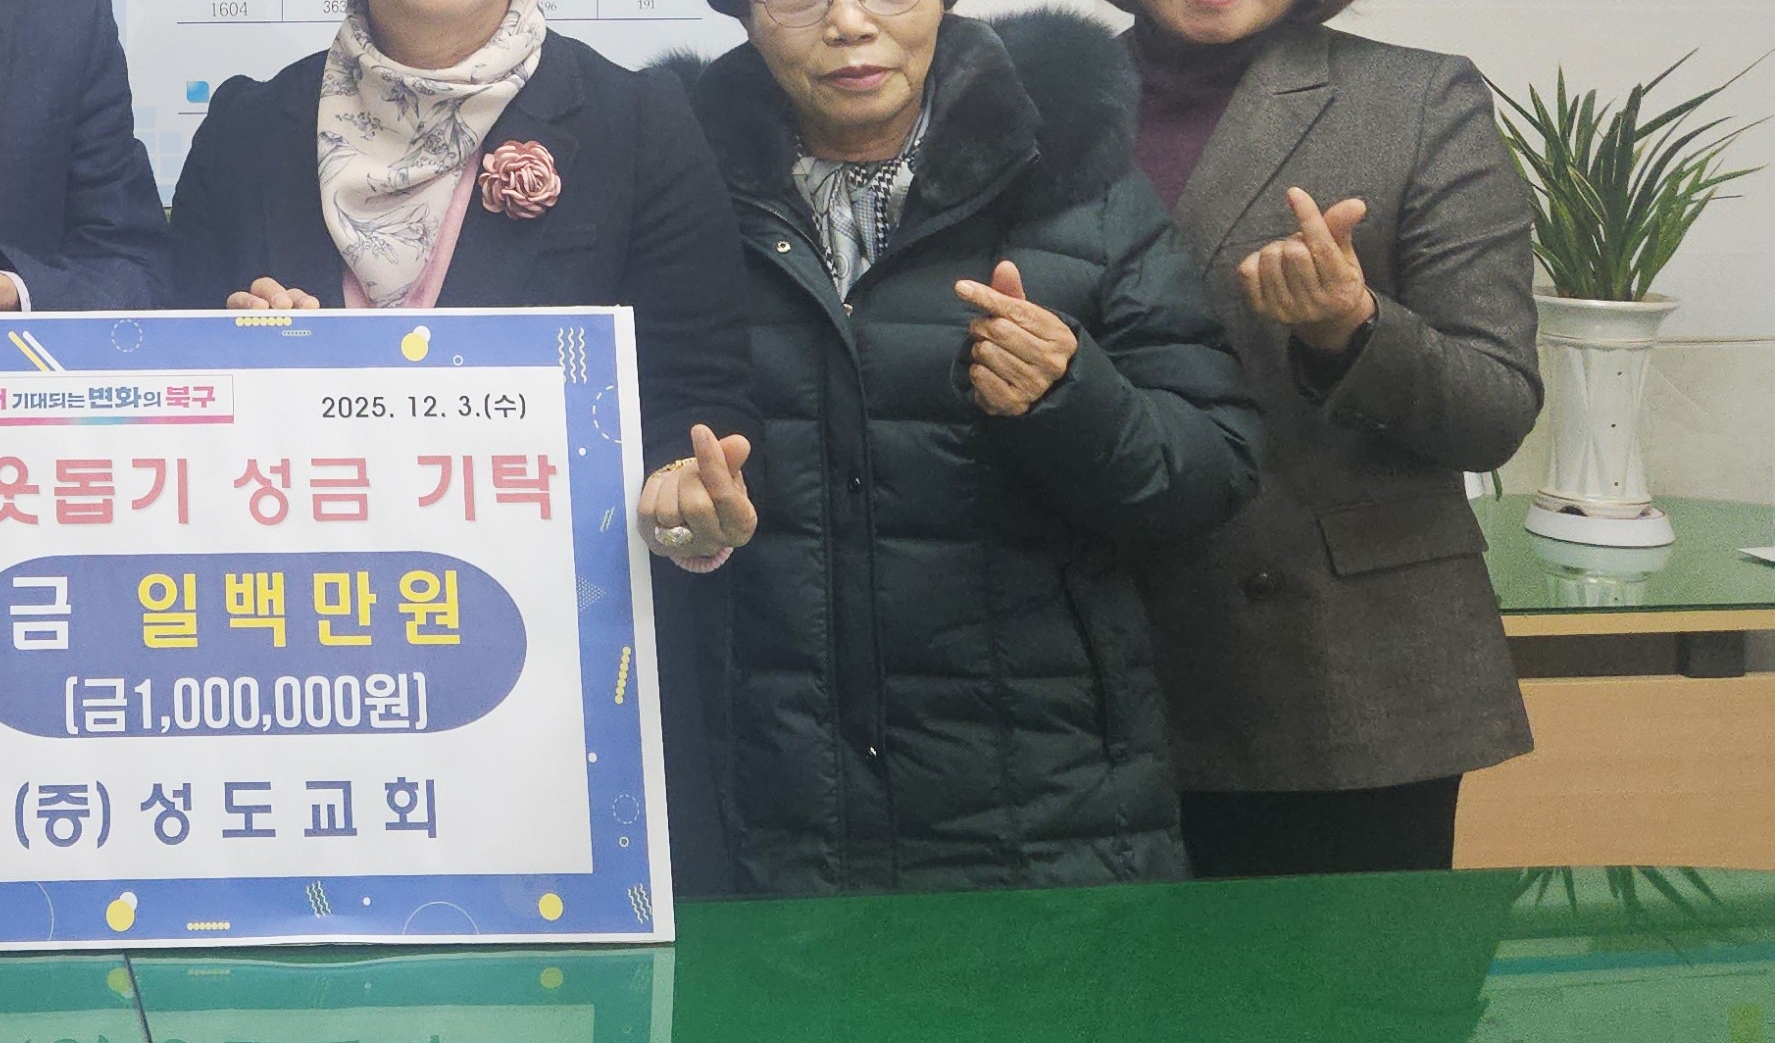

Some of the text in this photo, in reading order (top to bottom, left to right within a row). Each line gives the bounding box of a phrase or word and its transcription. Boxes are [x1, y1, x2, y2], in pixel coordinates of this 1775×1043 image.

[210, 1, 249, 17] 1604
[12, 392, 86, 410] 기대되는
[88, 386, 162, 409] 변화의
[165, 386, 217, 408] 북구
[322, 393, 526, 420] 2025. 12. 3.(수)
[233, 457, 371, 527] 성금
[417, 453, 558, 523] 기탁
[10, 569, 461, 651] 금 일백만원
[14, 776, 437, 850] (증) 성도교회
